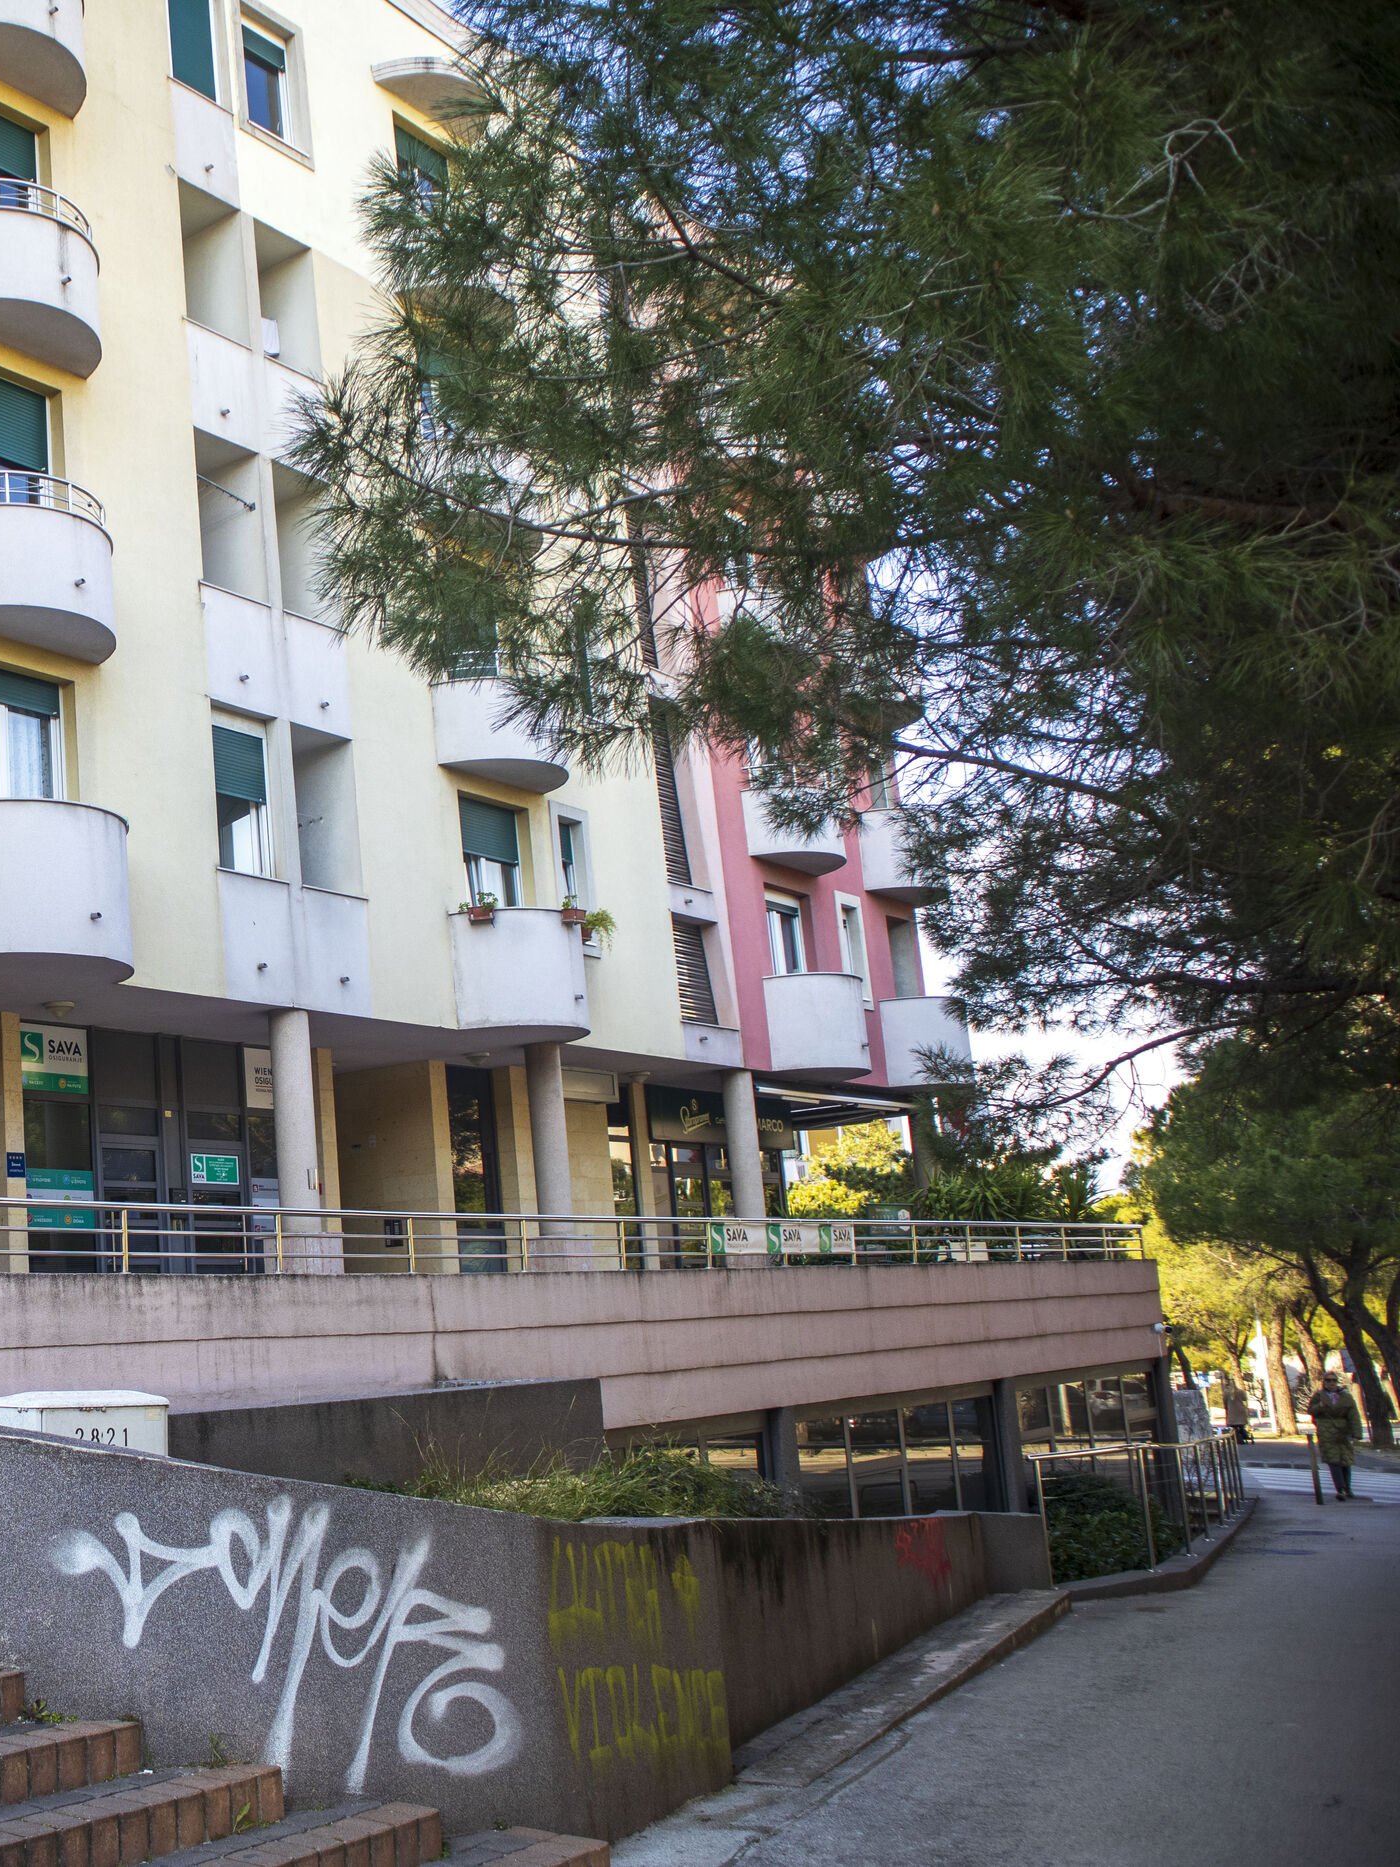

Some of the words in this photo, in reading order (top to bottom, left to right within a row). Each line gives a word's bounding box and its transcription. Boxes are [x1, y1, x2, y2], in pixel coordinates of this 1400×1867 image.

[48, 1039, 82, 1056] SAVA
[726, 1228, 749, 1242] SAVA
[782, 1228, 802, 1242] SAVA
[833, 1229, 851, 1242] SAVA
